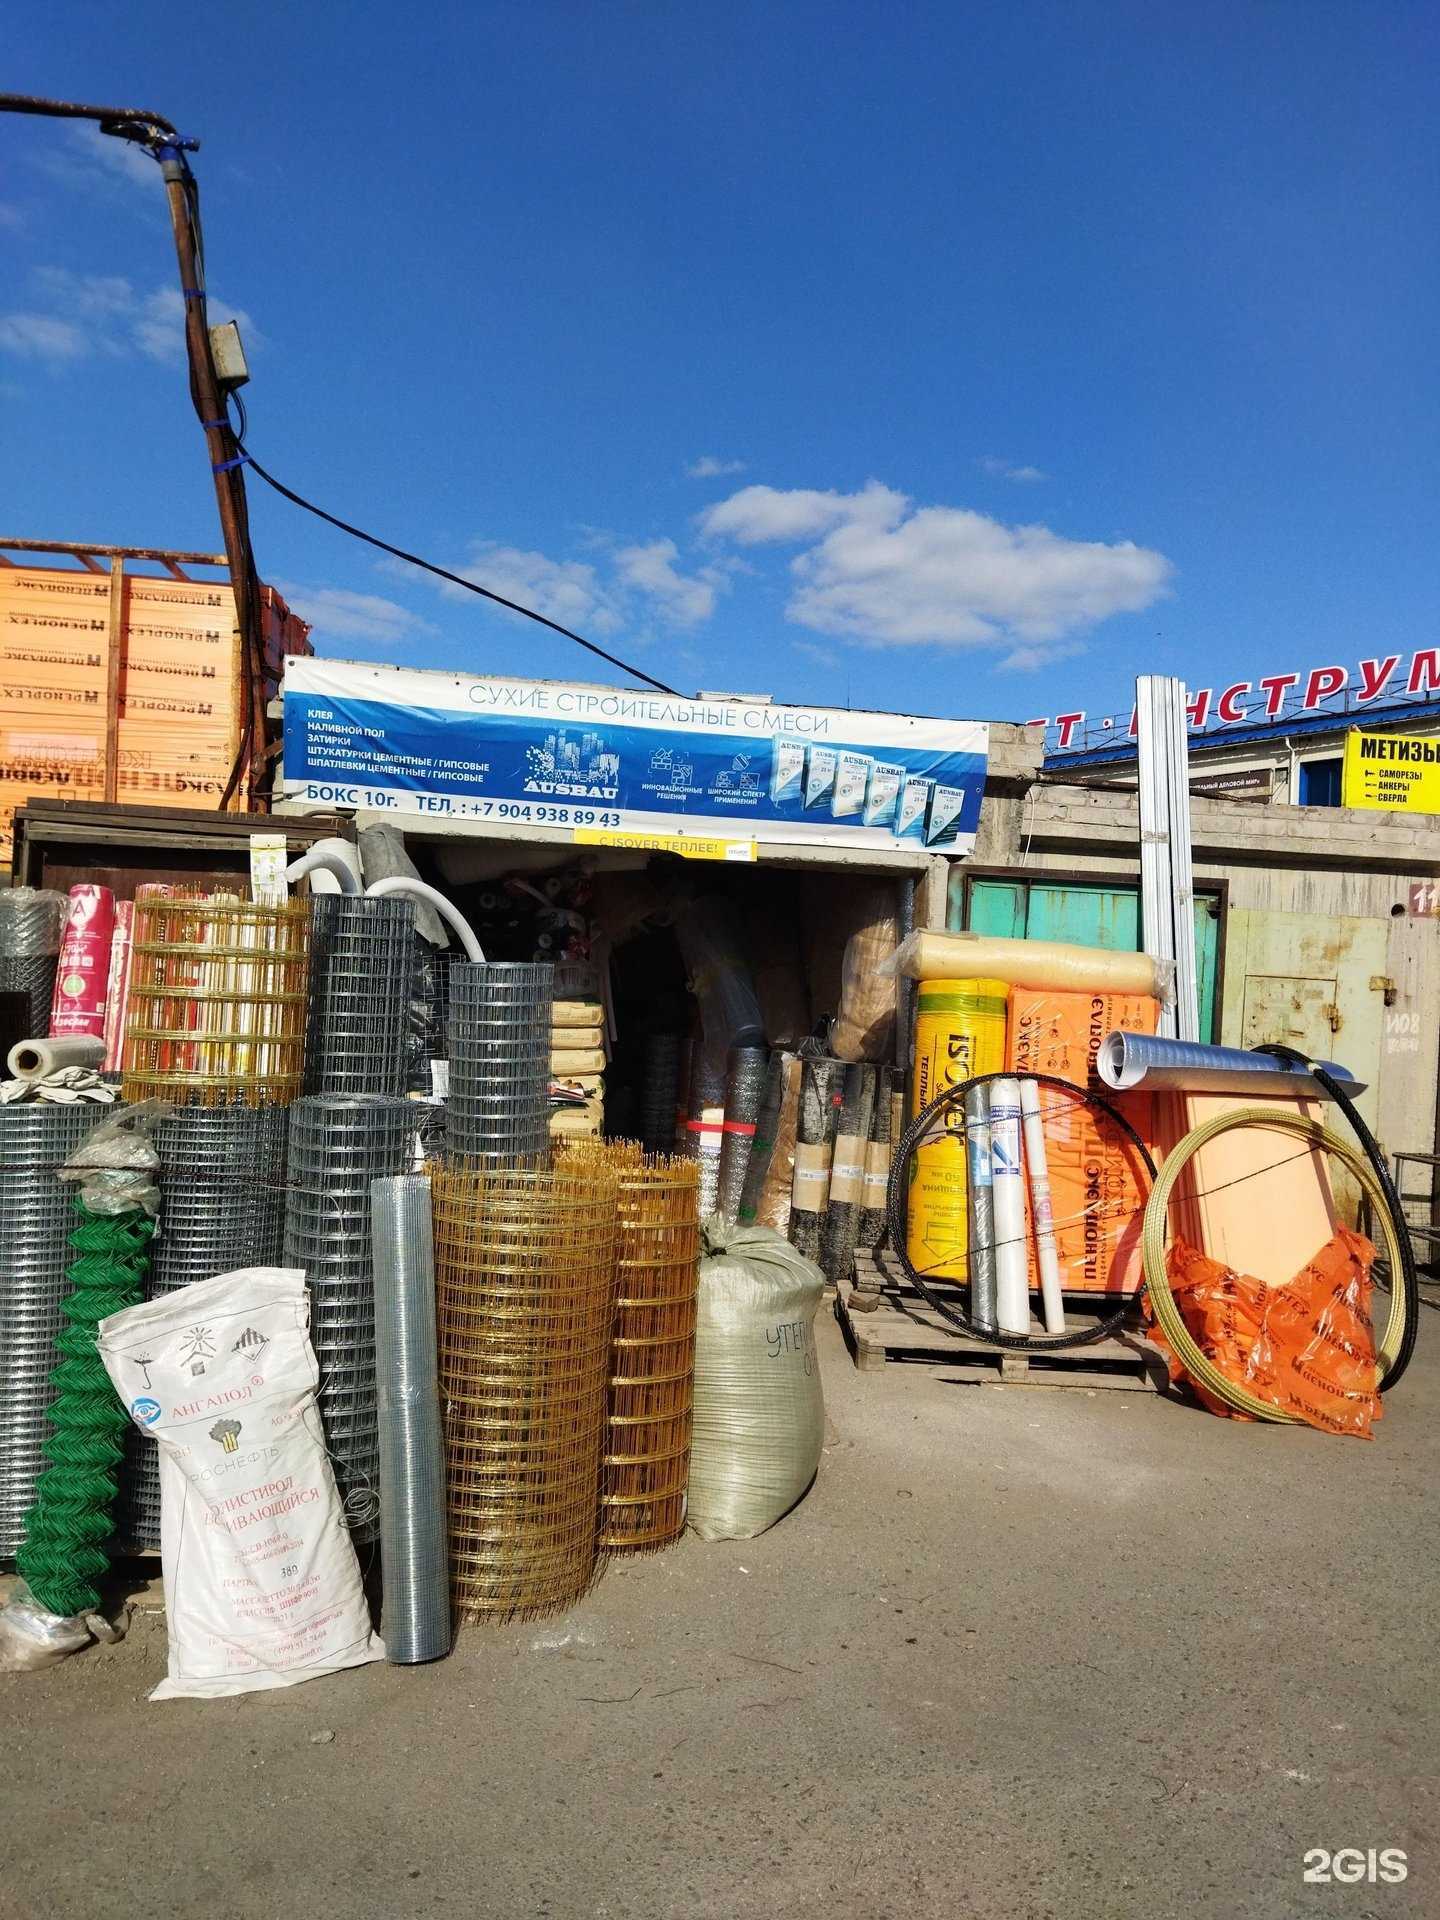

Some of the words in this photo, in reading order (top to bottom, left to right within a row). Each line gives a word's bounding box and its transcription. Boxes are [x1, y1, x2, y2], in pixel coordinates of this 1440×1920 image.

[307, 709, 333, 720] КЛЕЯ
[469, 685, 549, 710] СУХИЕ
[556, 693, 737, 727] СТРОИТЕЛЬНЫЕ
[743, 710, 829, 733] СМЕСИ
[307, 722, 363, 735] НАЛИВНОЙ
[364, 727, 385, 738] ПОЛ
[307, 733, 351, 746] ЗАТИРКИ
[307, 746, 371, 760] ШТУКАТУРКИ
[372, 752, 433, 768] ЦЕМЕНТНЫЕ
[439, 759, 490, 772] ГИПСОВЫЕ
[307, 757, 366, 771] ШПАТЛЕВКИ
[367, 764, 426, 779] ЦЕМЕНТНЫЕ
[433, 770, 484, 783] ГИПСОВЫЕ
[1379, 769, 1422, 780] САМОРЕЗЫ
[523, 780, 619, 800] AUSBAU
[1378, 781, 1410, 791] АНКЕРЫ
[1377, 793, 1407, 802] СВЕРЛА
[307, 785, 358, 803] БОКС
[471, 801, 492, 816] +7
[498, 803, 532, 820] 904
[536, 807, 569, 822] 938
[573, 810, 595, 824] 89
[598, 812, 621, 828] 43
[664, 839, 719, 854] ТЕПЛЕЕ!
[190, 1448, 279, 1482] РОСНЕФТЬ
